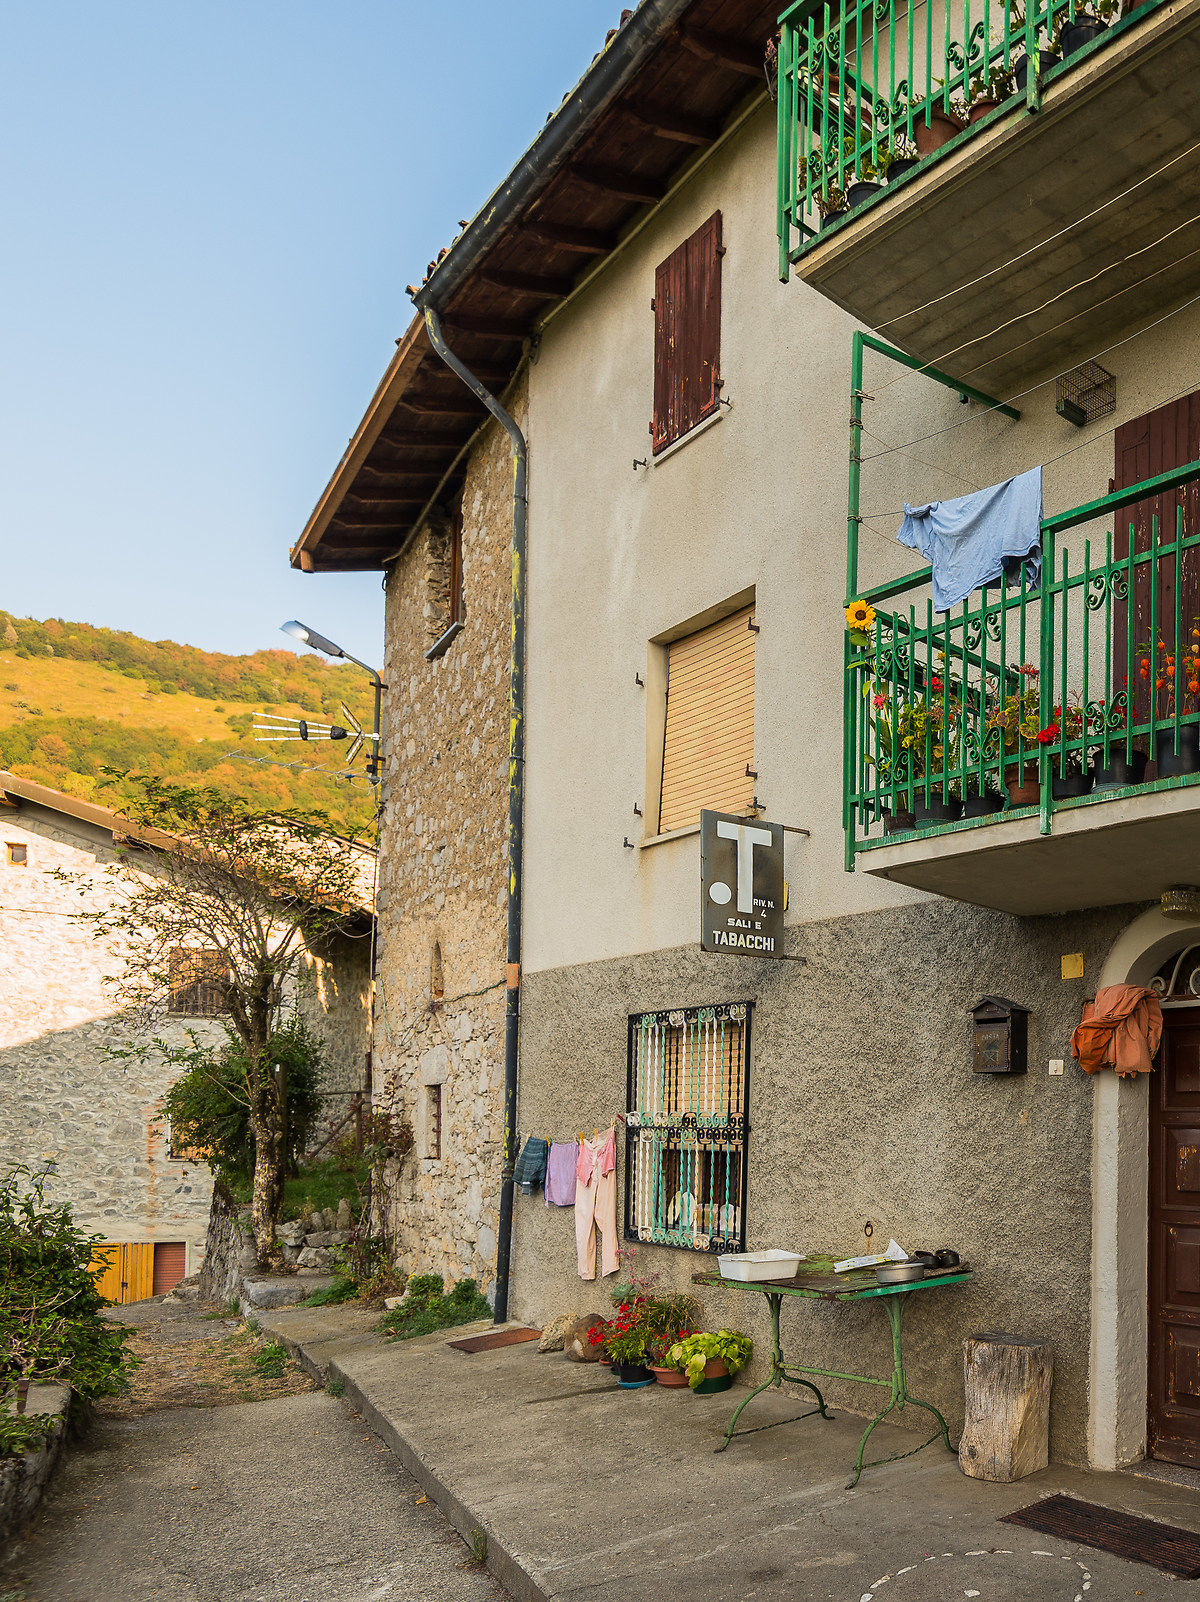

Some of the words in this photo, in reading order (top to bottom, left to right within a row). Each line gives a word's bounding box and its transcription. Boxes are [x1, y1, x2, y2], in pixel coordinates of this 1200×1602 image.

[716, 820, 772, 914] T
[760, 909, 767, 918] 4
[727, 918, 751, 929] SALI
[755, 921, 762, 930] E
[712, 930, 775, 952] TABACCHI
